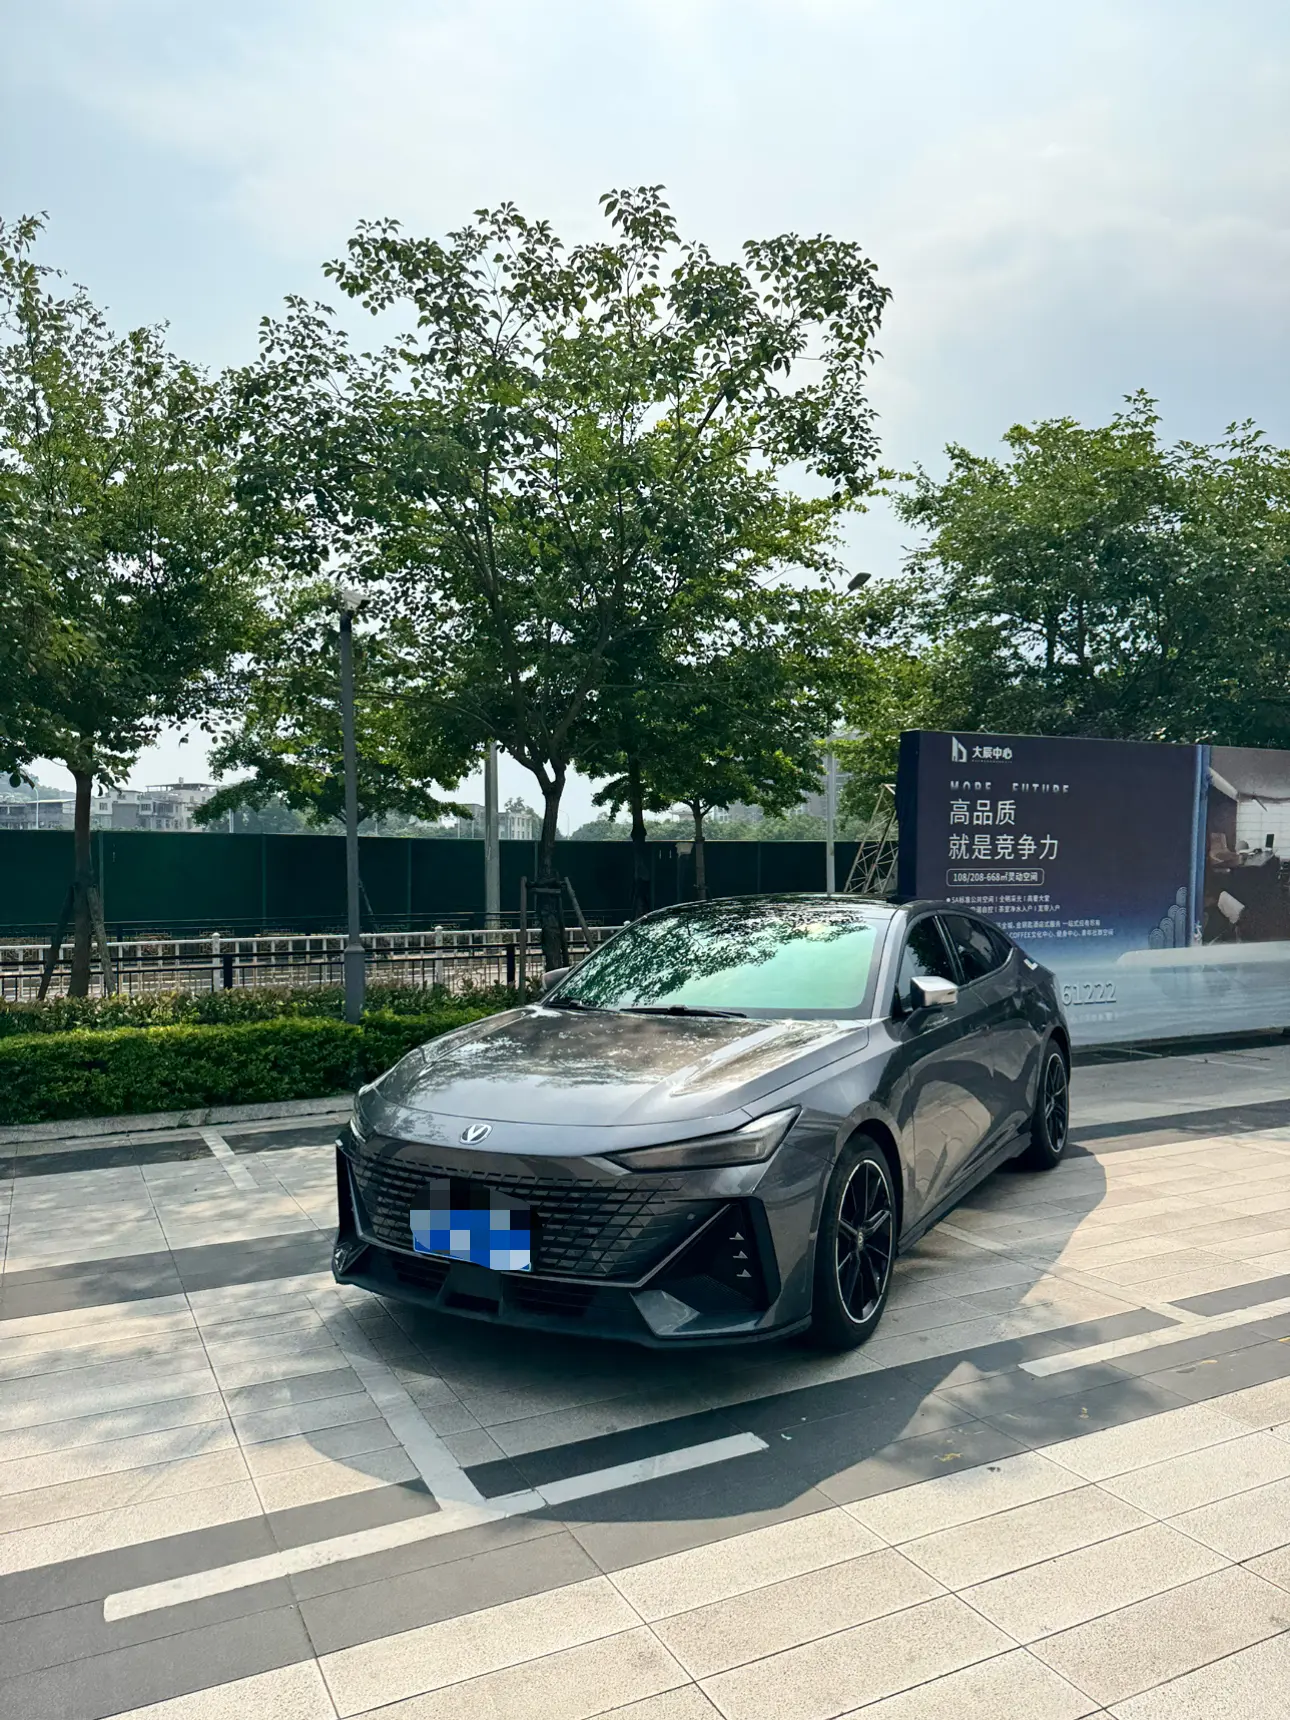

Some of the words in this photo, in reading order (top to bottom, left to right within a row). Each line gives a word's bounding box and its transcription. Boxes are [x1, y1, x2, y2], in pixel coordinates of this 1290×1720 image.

[971, 745, 1013, 760] 大辰中心
[949, 798, 1017, 826] 高品质
[948, 833, 1059, 860] 就是竞争力
[1062, 981, 1117, 1006] 61222
